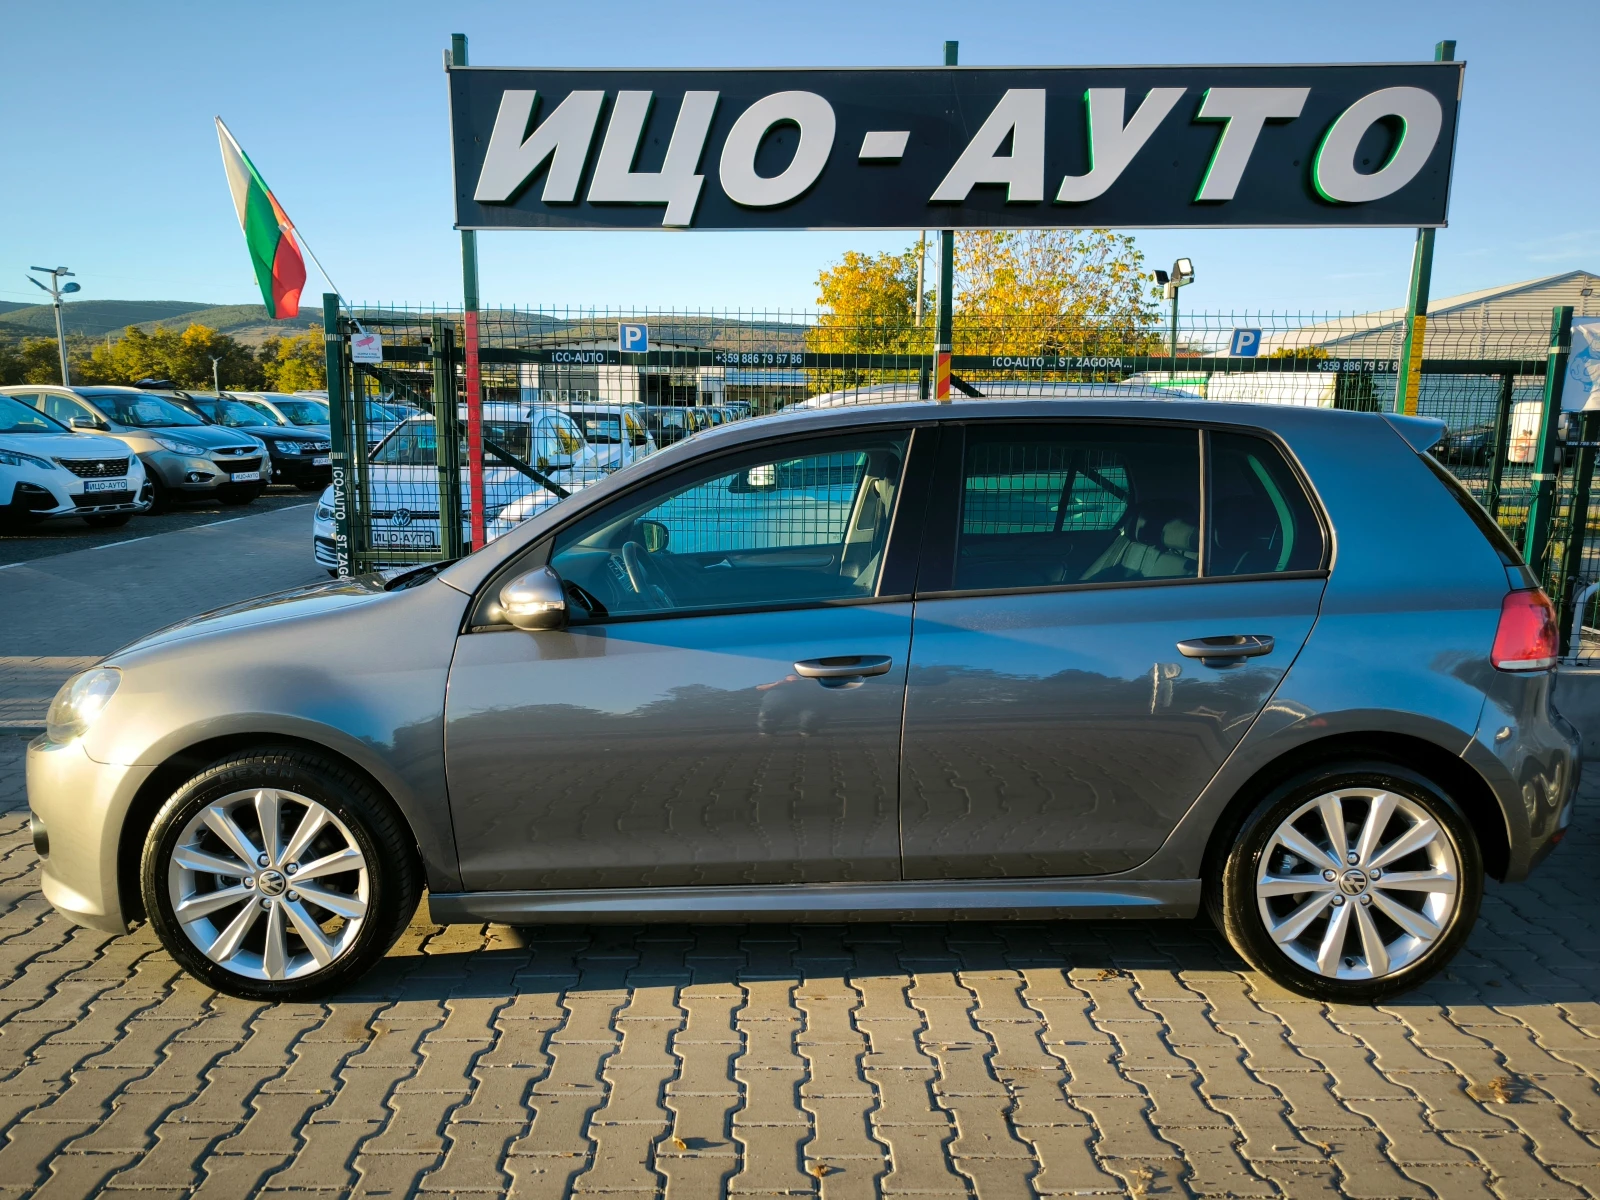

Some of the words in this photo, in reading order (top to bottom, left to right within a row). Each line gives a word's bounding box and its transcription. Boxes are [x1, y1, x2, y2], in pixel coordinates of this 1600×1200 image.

[625, 327, 641, 348] P
[1236, 331, 1255, 353] P
[742, 354, 759, 363] 886
[1076, 358, 1121, 367] ZAGORA
[1343, 361, 1360, 371] 886
[1364, 361, 1375, 371] 79
[89, 481, 126, 490] ИЦО-АУТО
